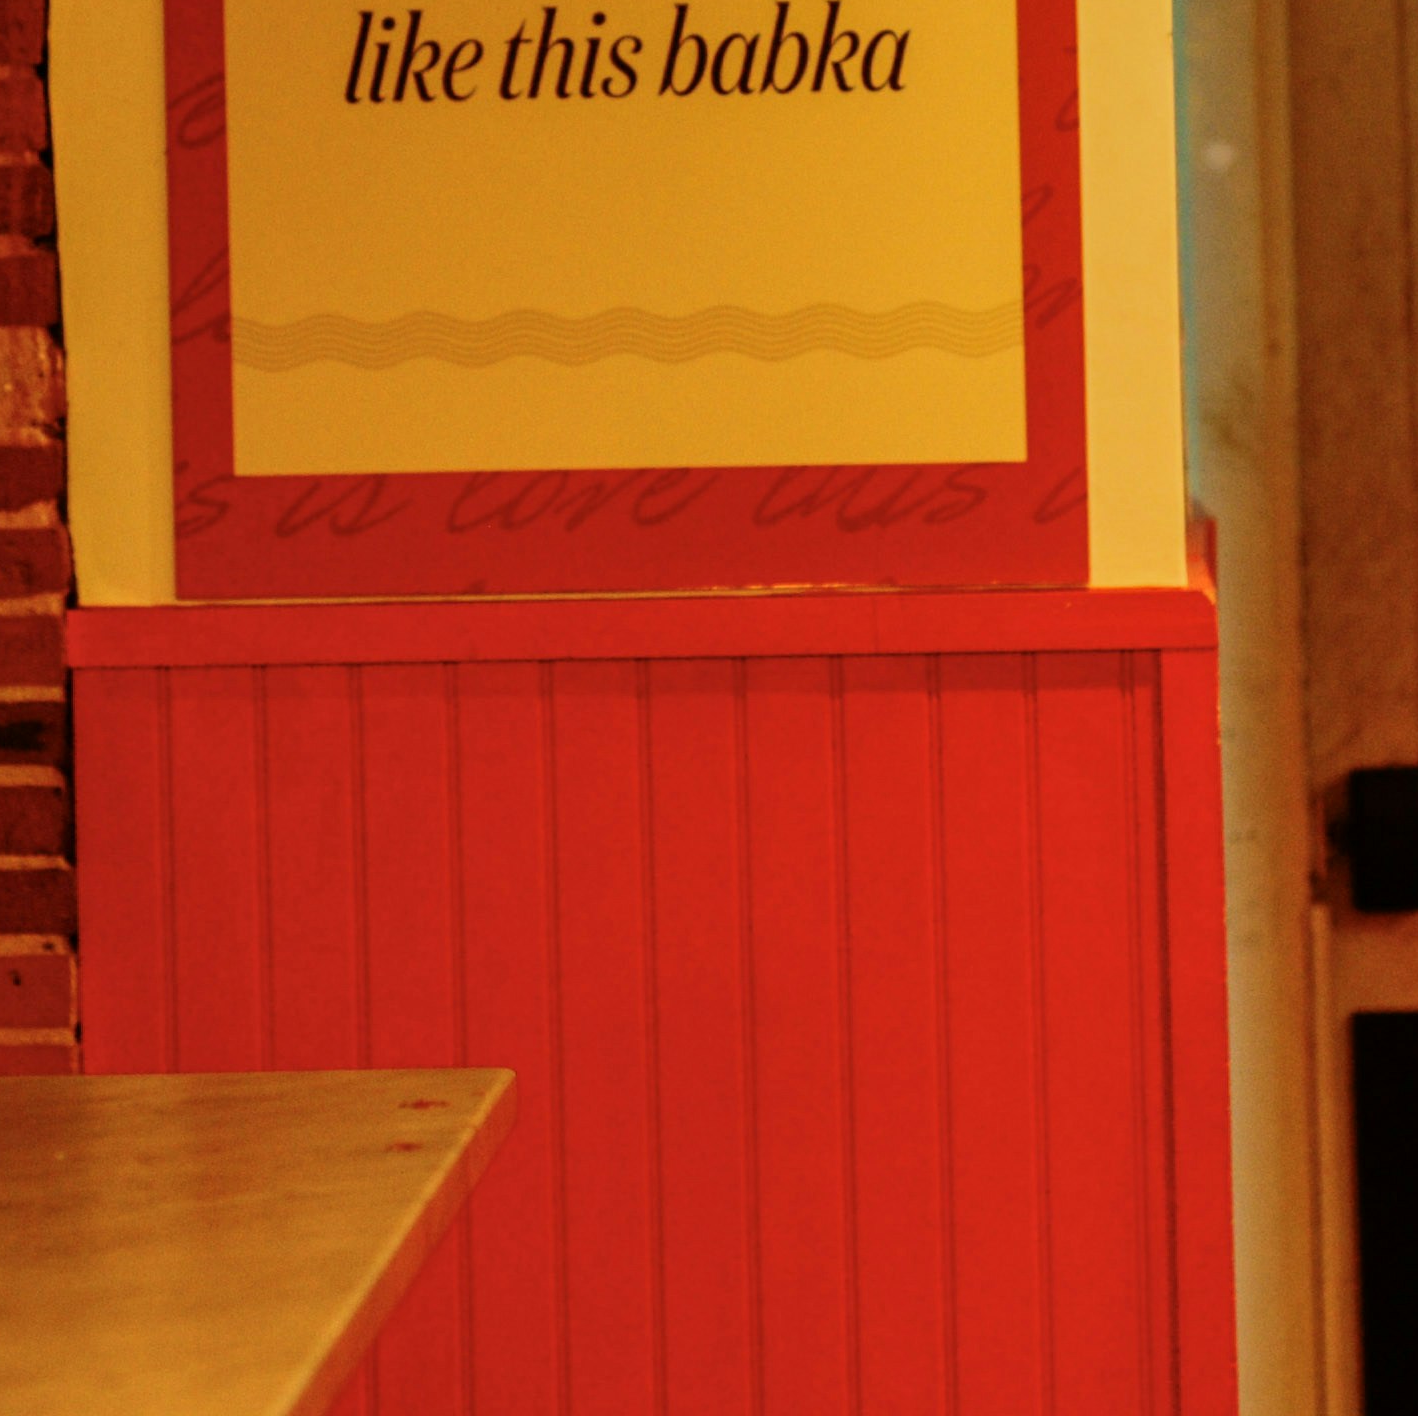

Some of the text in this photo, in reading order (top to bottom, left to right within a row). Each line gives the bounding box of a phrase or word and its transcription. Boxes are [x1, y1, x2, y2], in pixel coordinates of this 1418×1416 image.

[343, 0, 912, 105] like this babka
